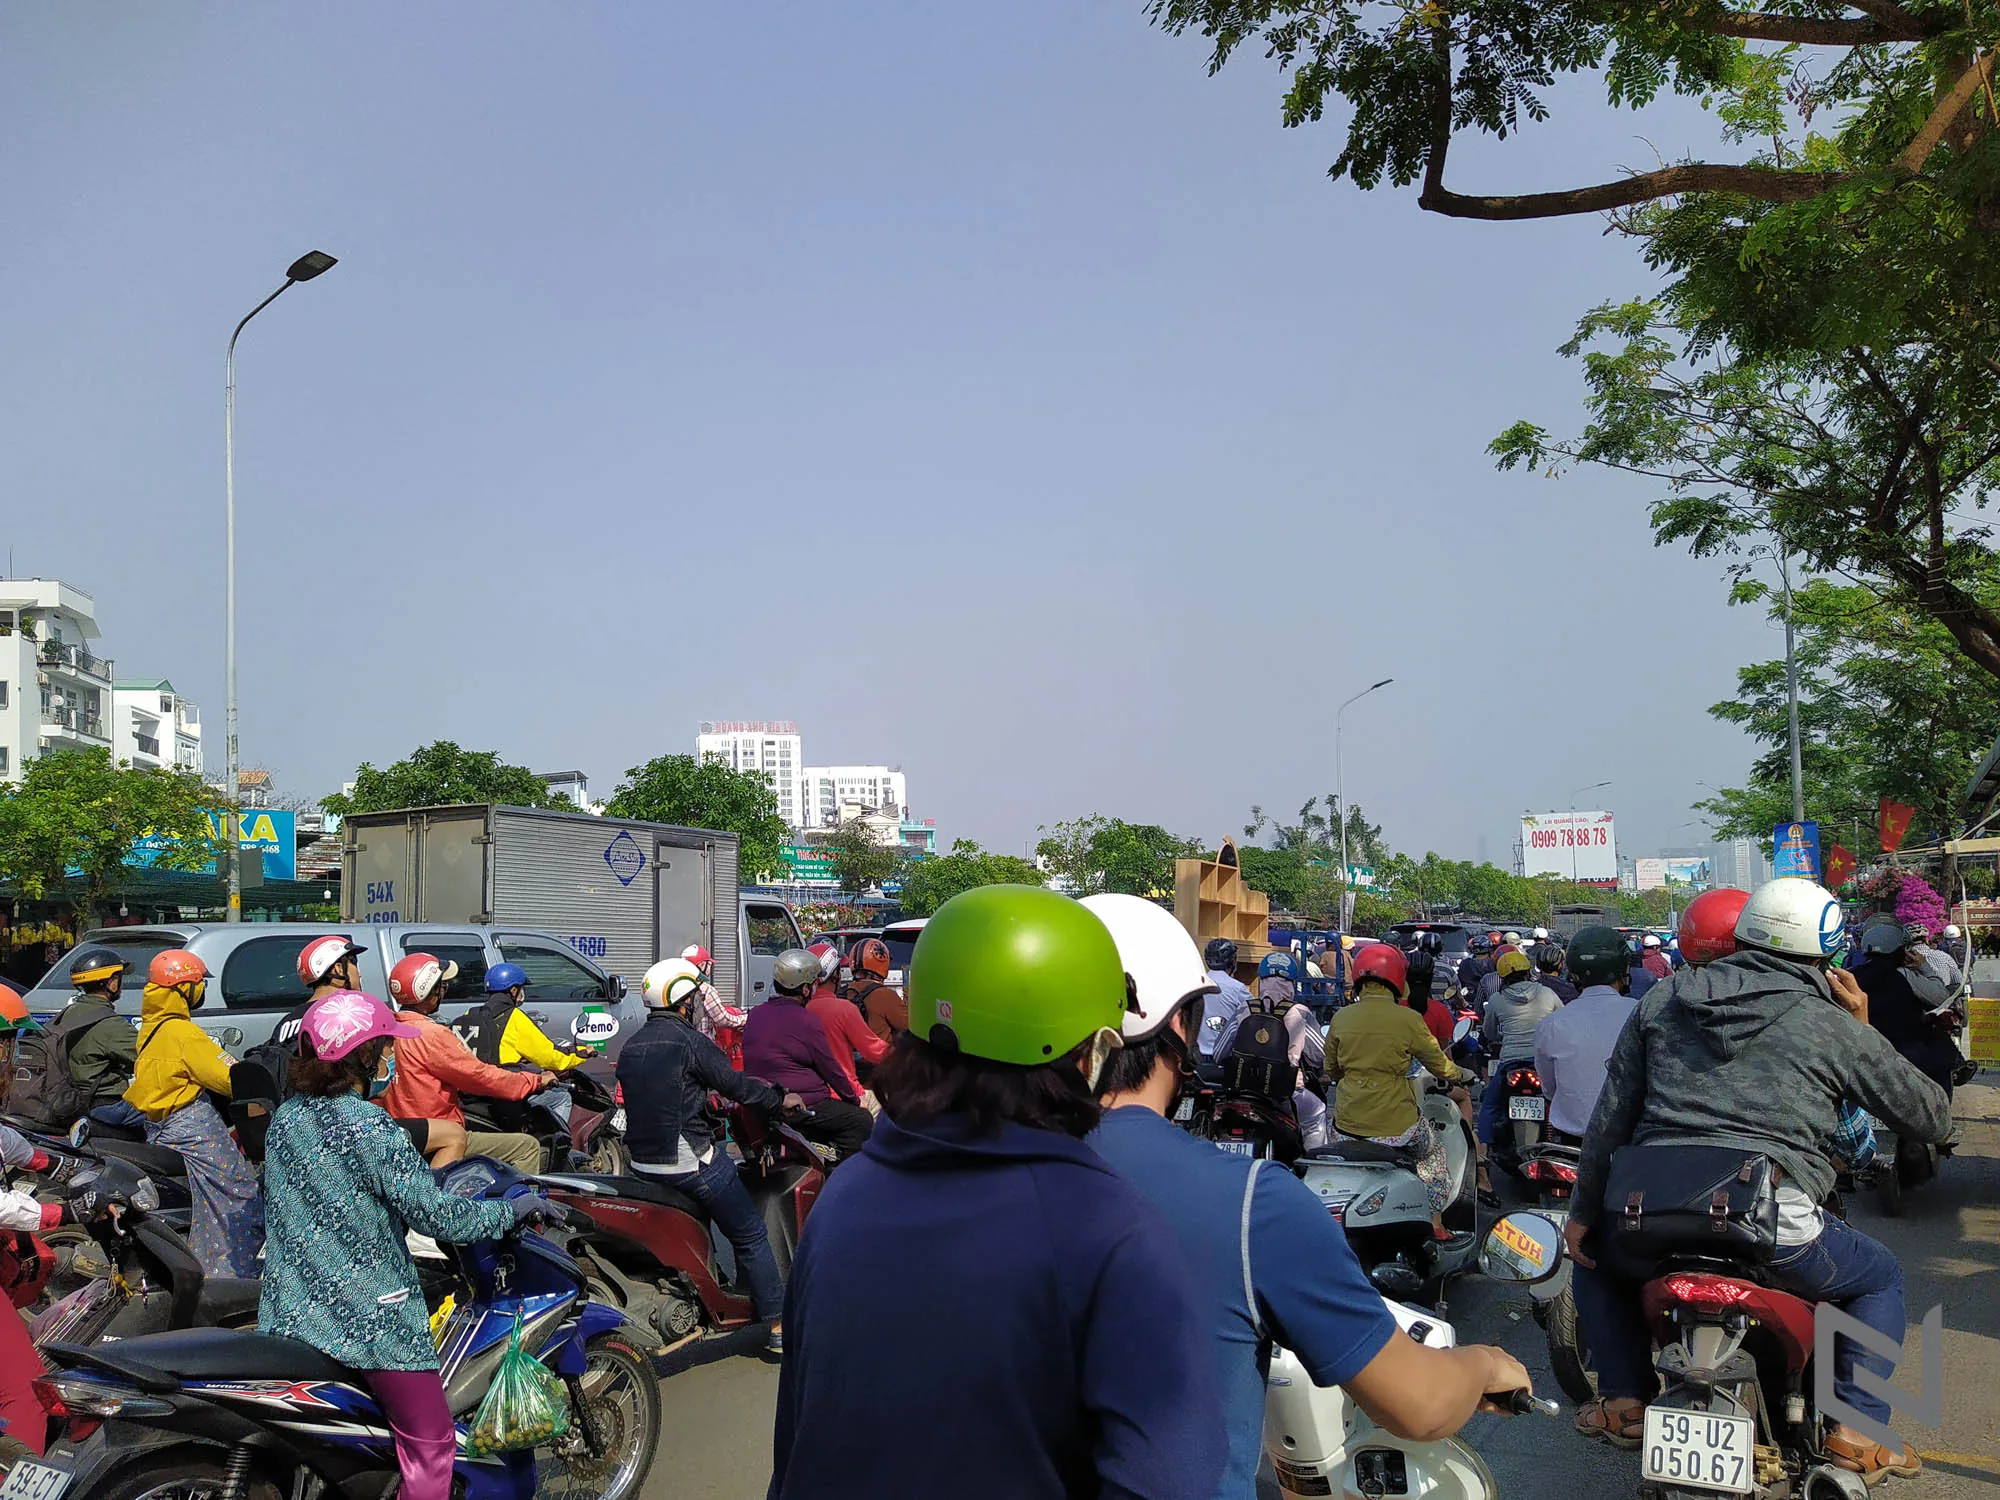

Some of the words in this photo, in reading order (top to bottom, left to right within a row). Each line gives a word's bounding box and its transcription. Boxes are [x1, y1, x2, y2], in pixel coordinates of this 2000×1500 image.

[1531, 829, 1557, 848] 0909
[1560, 828, 1574, 847] 78
[1576, 828, 1590, 846] 88
[1593, 827, 1607, 845] 78
[366, 880, 394, 905] 54X
[1514, 1099, 1541, 1109] 59-C2
[1661, 1413, 1736, 1451] 59-U2
[1650, 1445, 1745, 1486] 050.67
[10, 1463, 61, 1500] 59-C1
